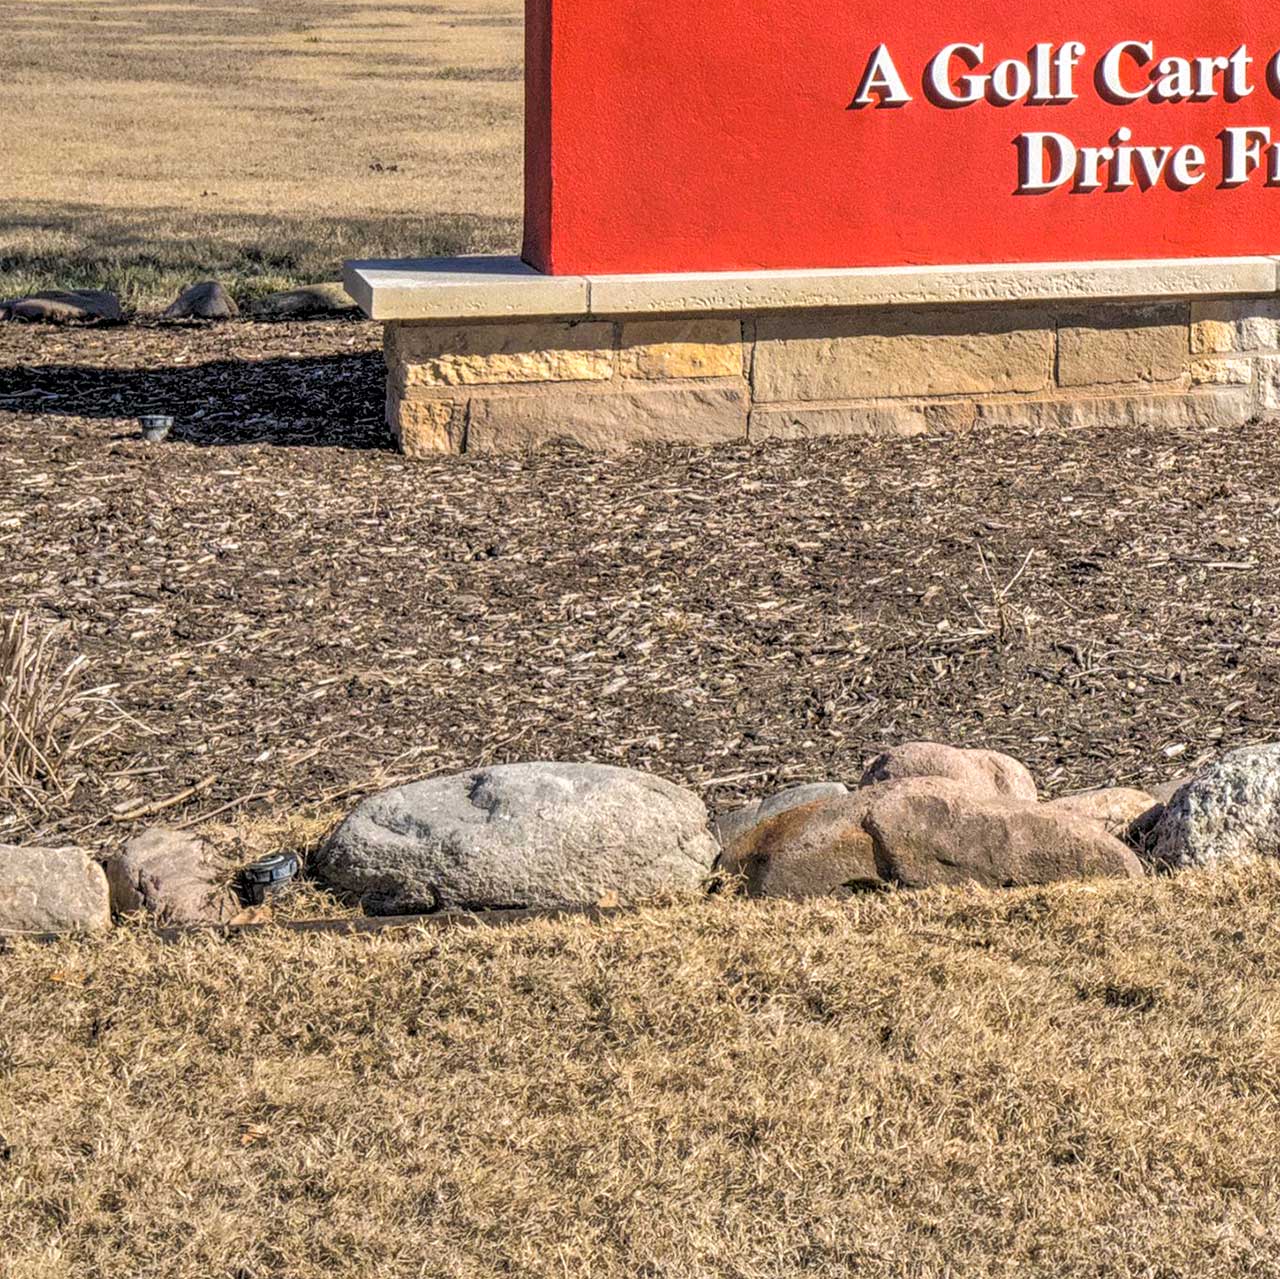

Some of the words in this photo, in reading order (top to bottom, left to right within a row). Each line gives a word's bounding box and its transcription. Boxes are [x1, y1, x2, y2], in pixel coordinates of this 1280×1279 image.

[857, 43, 912, 102] A
[932, 40, 1087, 103] Golf
[1103, 40, 1254, 100] Cart
[1022, 123, 1205, 189] Drive
